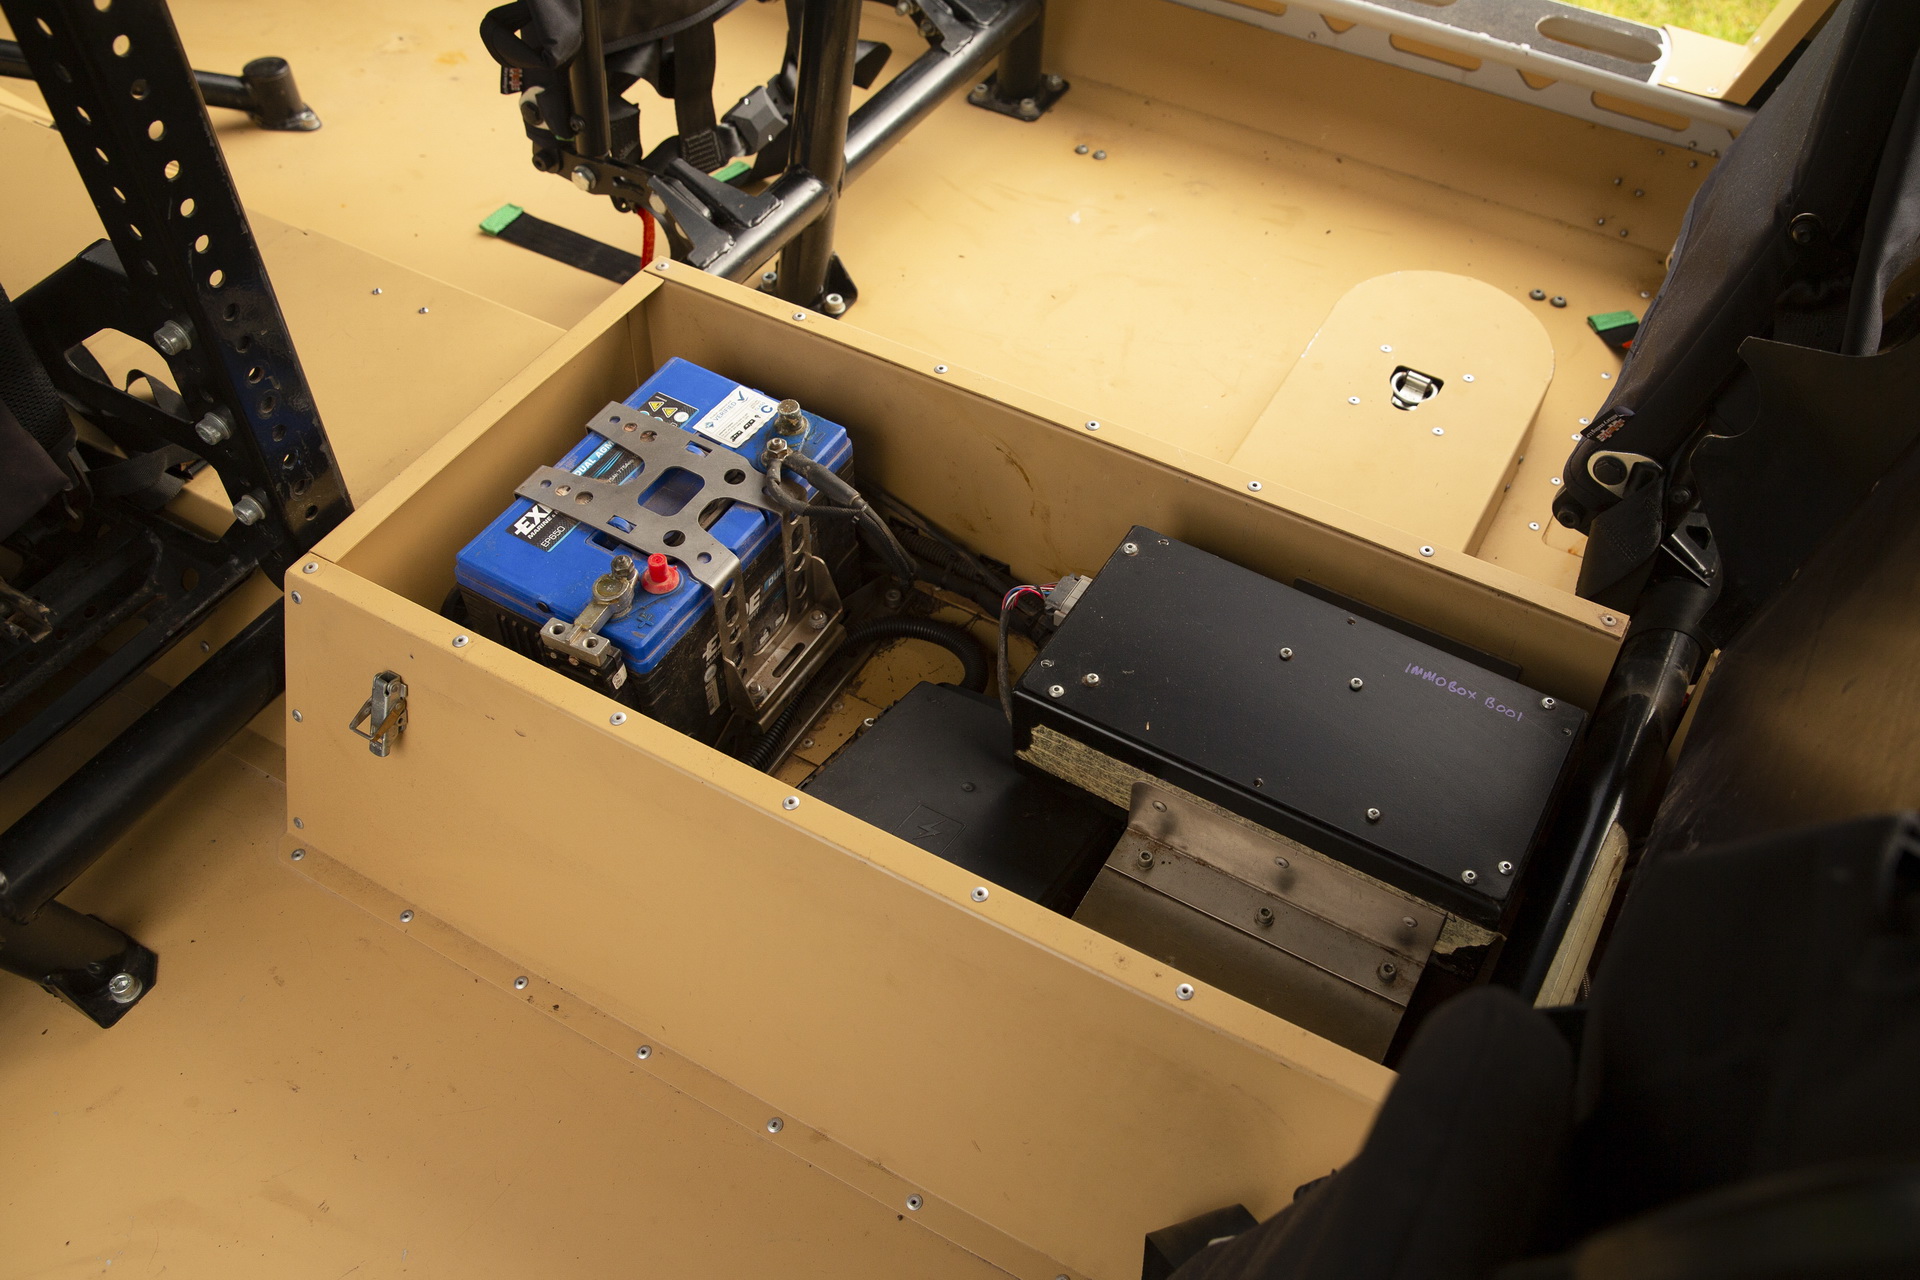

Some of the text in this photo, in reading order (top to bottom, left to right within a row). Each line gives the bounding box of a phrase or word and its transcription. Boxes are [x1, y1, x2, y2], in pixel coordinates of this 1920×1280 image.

[713, 402, 737, 422] VERIFIED
[760, 405, 773, 414] C
[572, 440, 615, 476] DUAL AGM
[528, 516, 552, 540] MARINE
[541, 525, 566, 548] EP650
[1405, 663, 1477, 699] IMMOBOX
